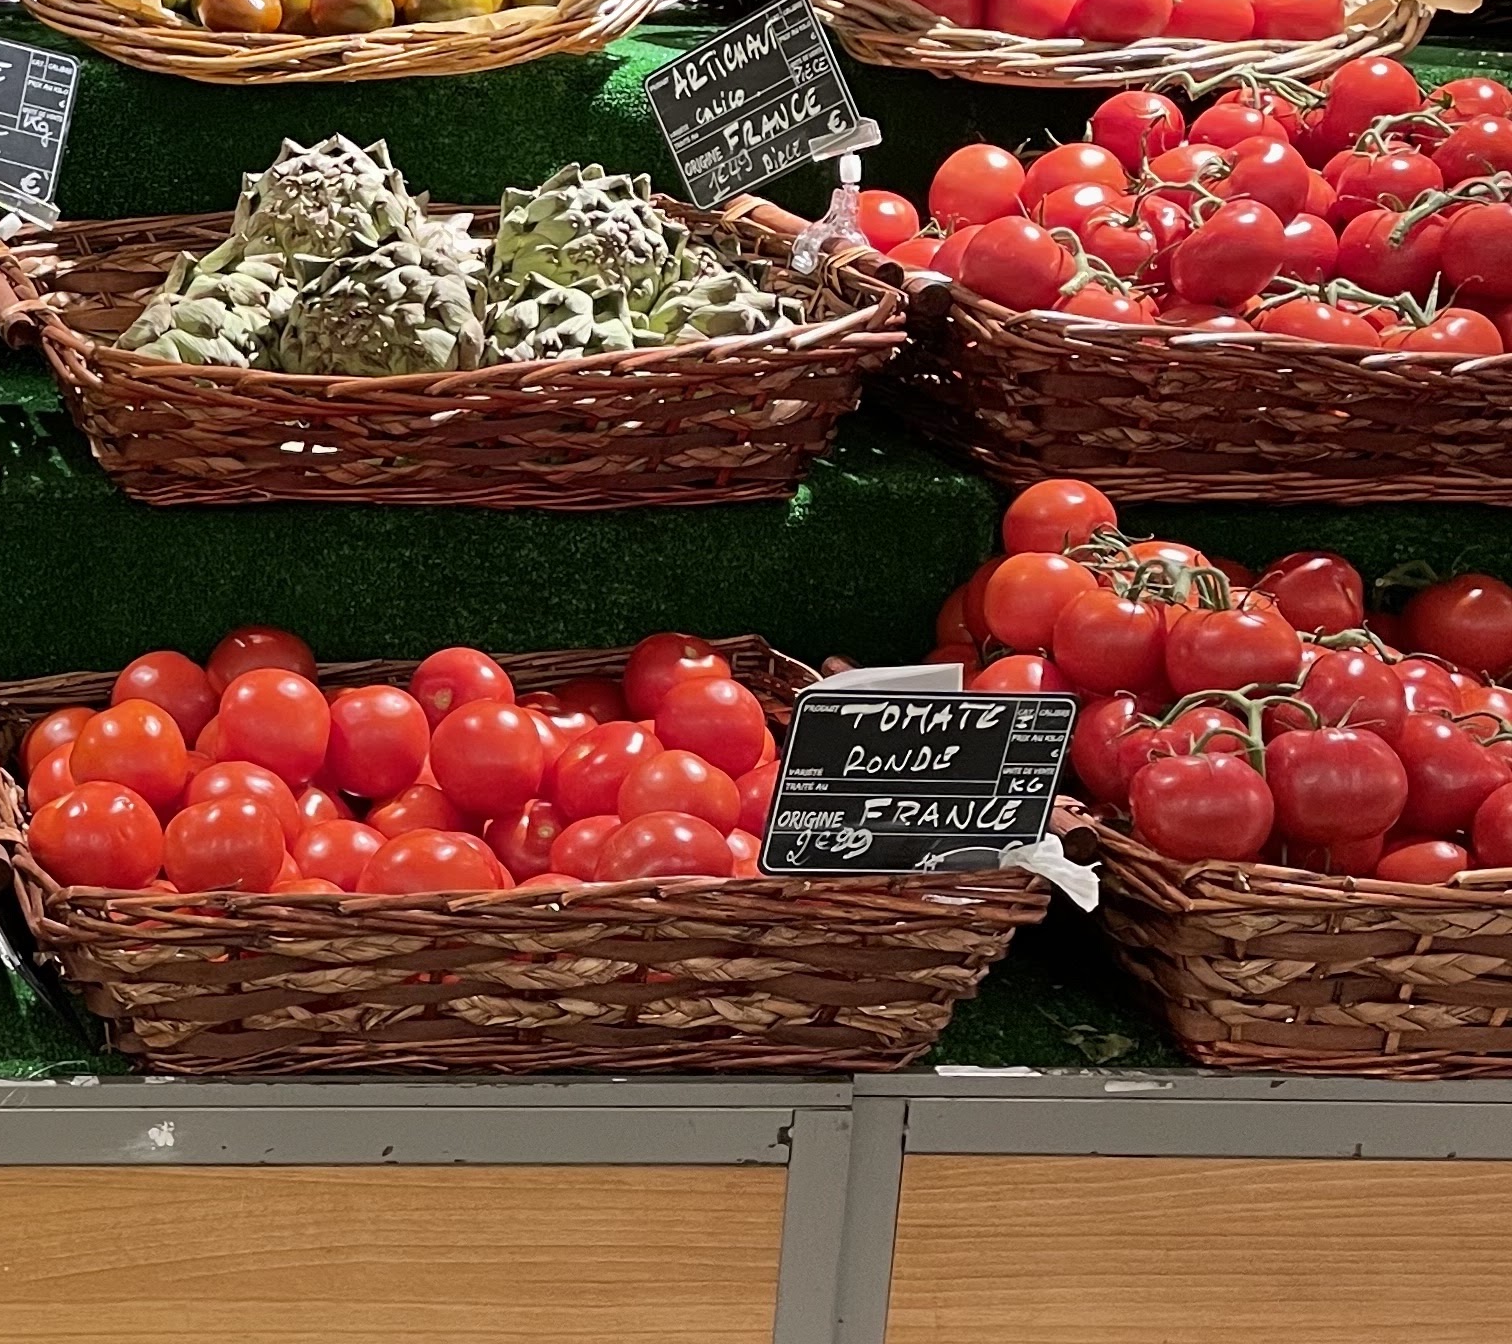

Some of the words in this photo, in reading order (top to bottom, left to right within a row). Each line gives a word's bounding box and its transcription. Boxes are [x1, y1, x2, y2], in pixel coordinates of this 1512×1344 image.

[672, 14, 784, 100] ARTICHAUT
[684, 146, 724, 177] ORIGINE
[723, 86, 822, 153] FRANCE
[841, 701, 1006, 735] TOMATE
[843, 745, 959, 777] RONDE
[1007, 777, 1044, 794] KG
[777, 810, 845, 830] ORIGINE
[859, 796, 1023, 832] FRANCE
